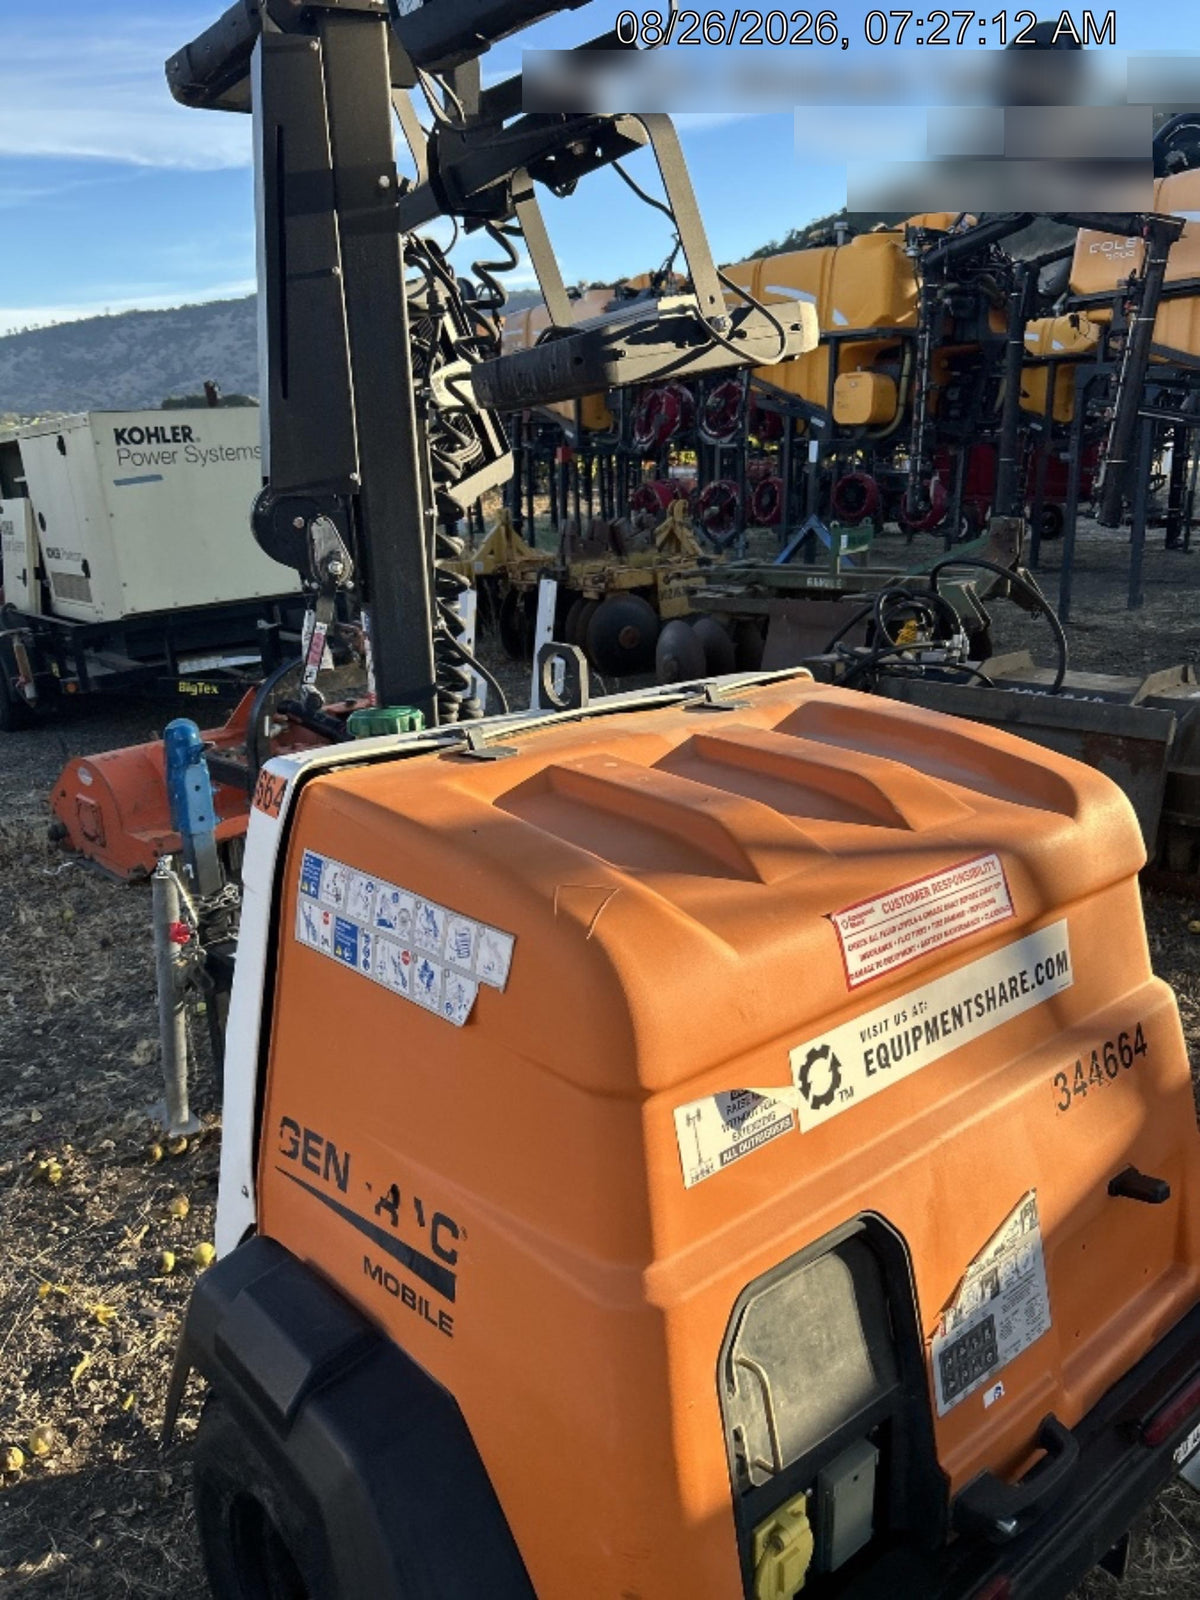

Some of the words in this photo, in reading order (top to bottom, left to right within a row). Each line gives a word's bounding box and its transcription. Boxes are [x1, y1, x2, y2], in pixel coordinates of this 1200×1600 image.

[113, 424, 195, 446] KOHLER
[116, 447, 178, 466] Power
[183, 444, 262, 467] Systems
[880, 884, 931, 915] CUSTOMER
[860, 1018, 889, 1043] VISIT
[894, 1010, 908, 1026] US
[912, 1001, 927, 1017] AT:
[863, 949, 1068, 1077] EQUIPMENTSHARE.COM
[1054, 1021, 1147, 1112] 344664
[363, 1255, 454, 1338] MOBILE
